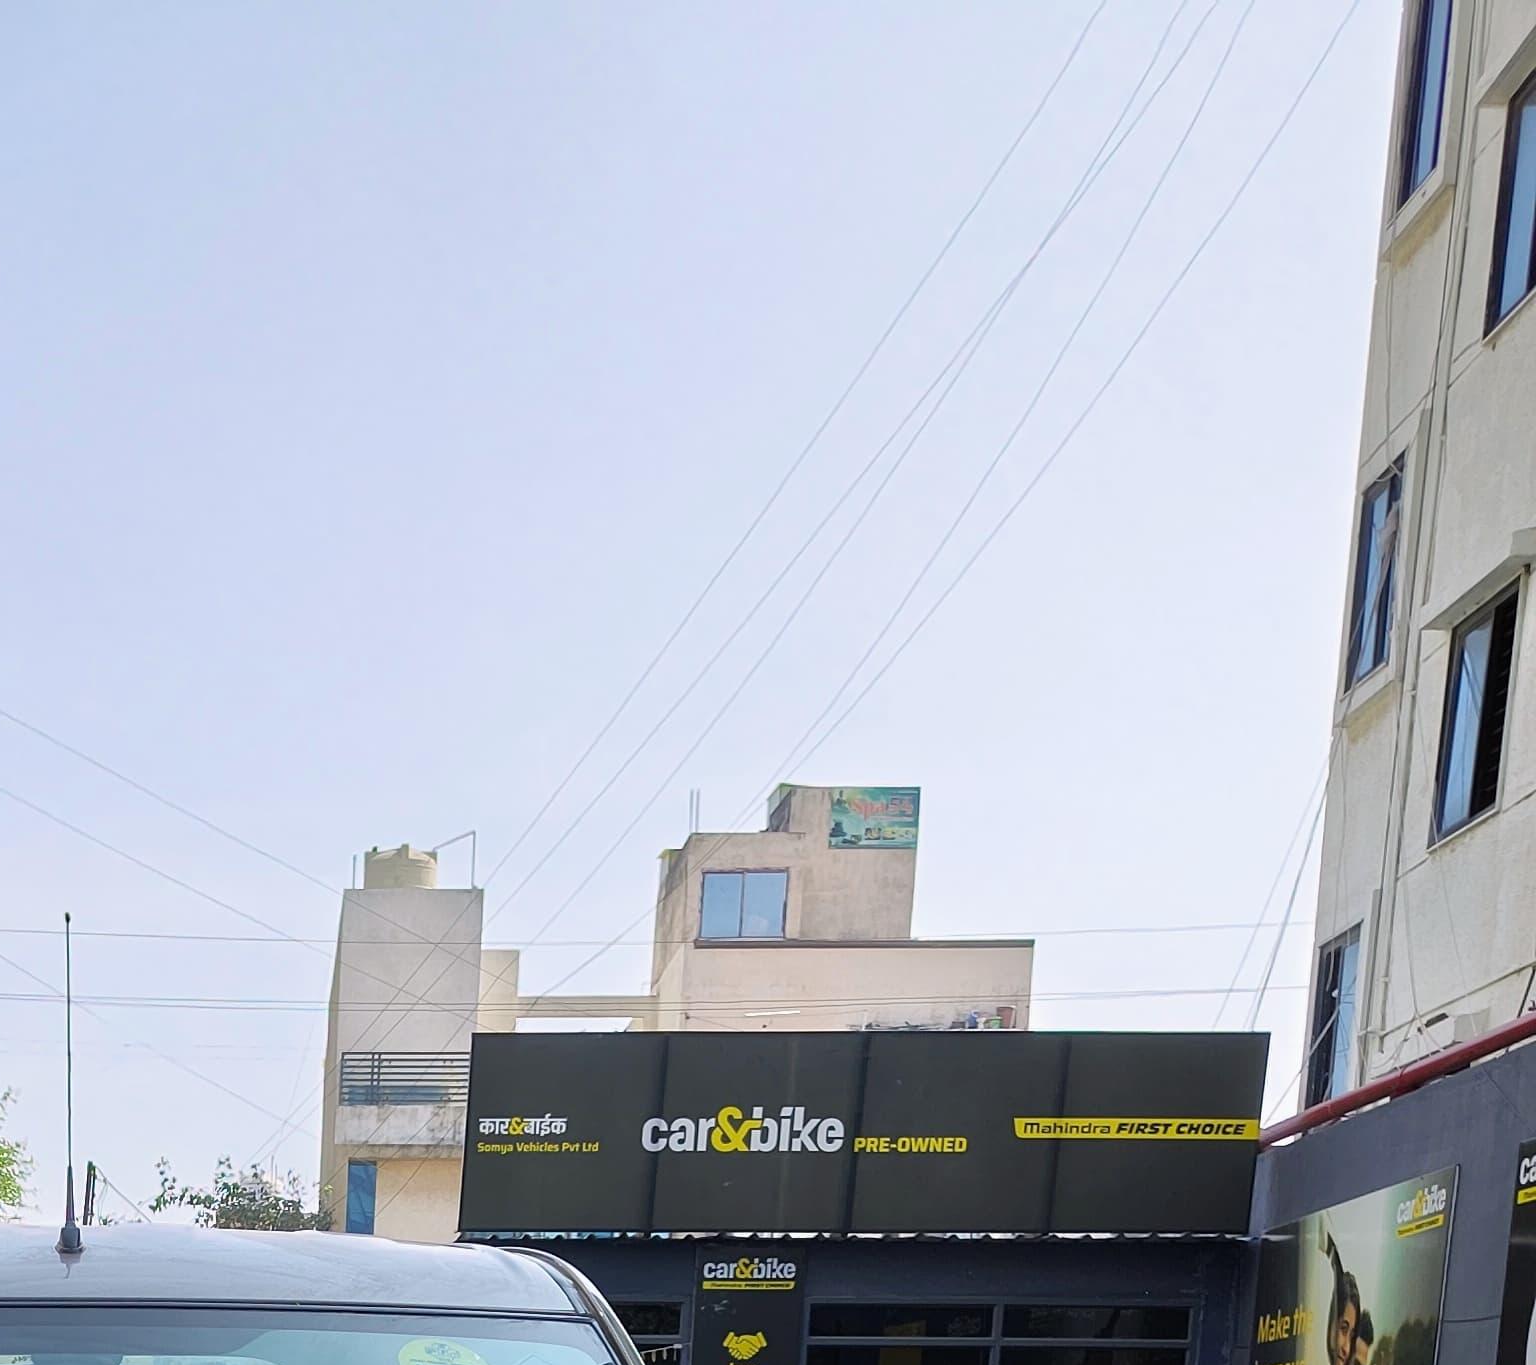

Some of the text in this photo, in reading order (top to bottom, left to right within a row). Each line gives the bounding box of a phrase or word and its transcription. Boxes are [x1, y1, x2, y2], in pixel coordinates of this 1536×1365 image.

[641, 1106, 968, 1153] car&bike PRE-OWNED
[1023, 1122, 1246, 1136] Mahindra FIRST CHOICE
[477, 1141, 599, 1154] Somya Vehicles Pvt Ltd
[1396, 1184, 1447, 1225] car&bike
[703, 1257, 797, 1279] car&bike
[1257, 1303, 1313, 1345] Make the
